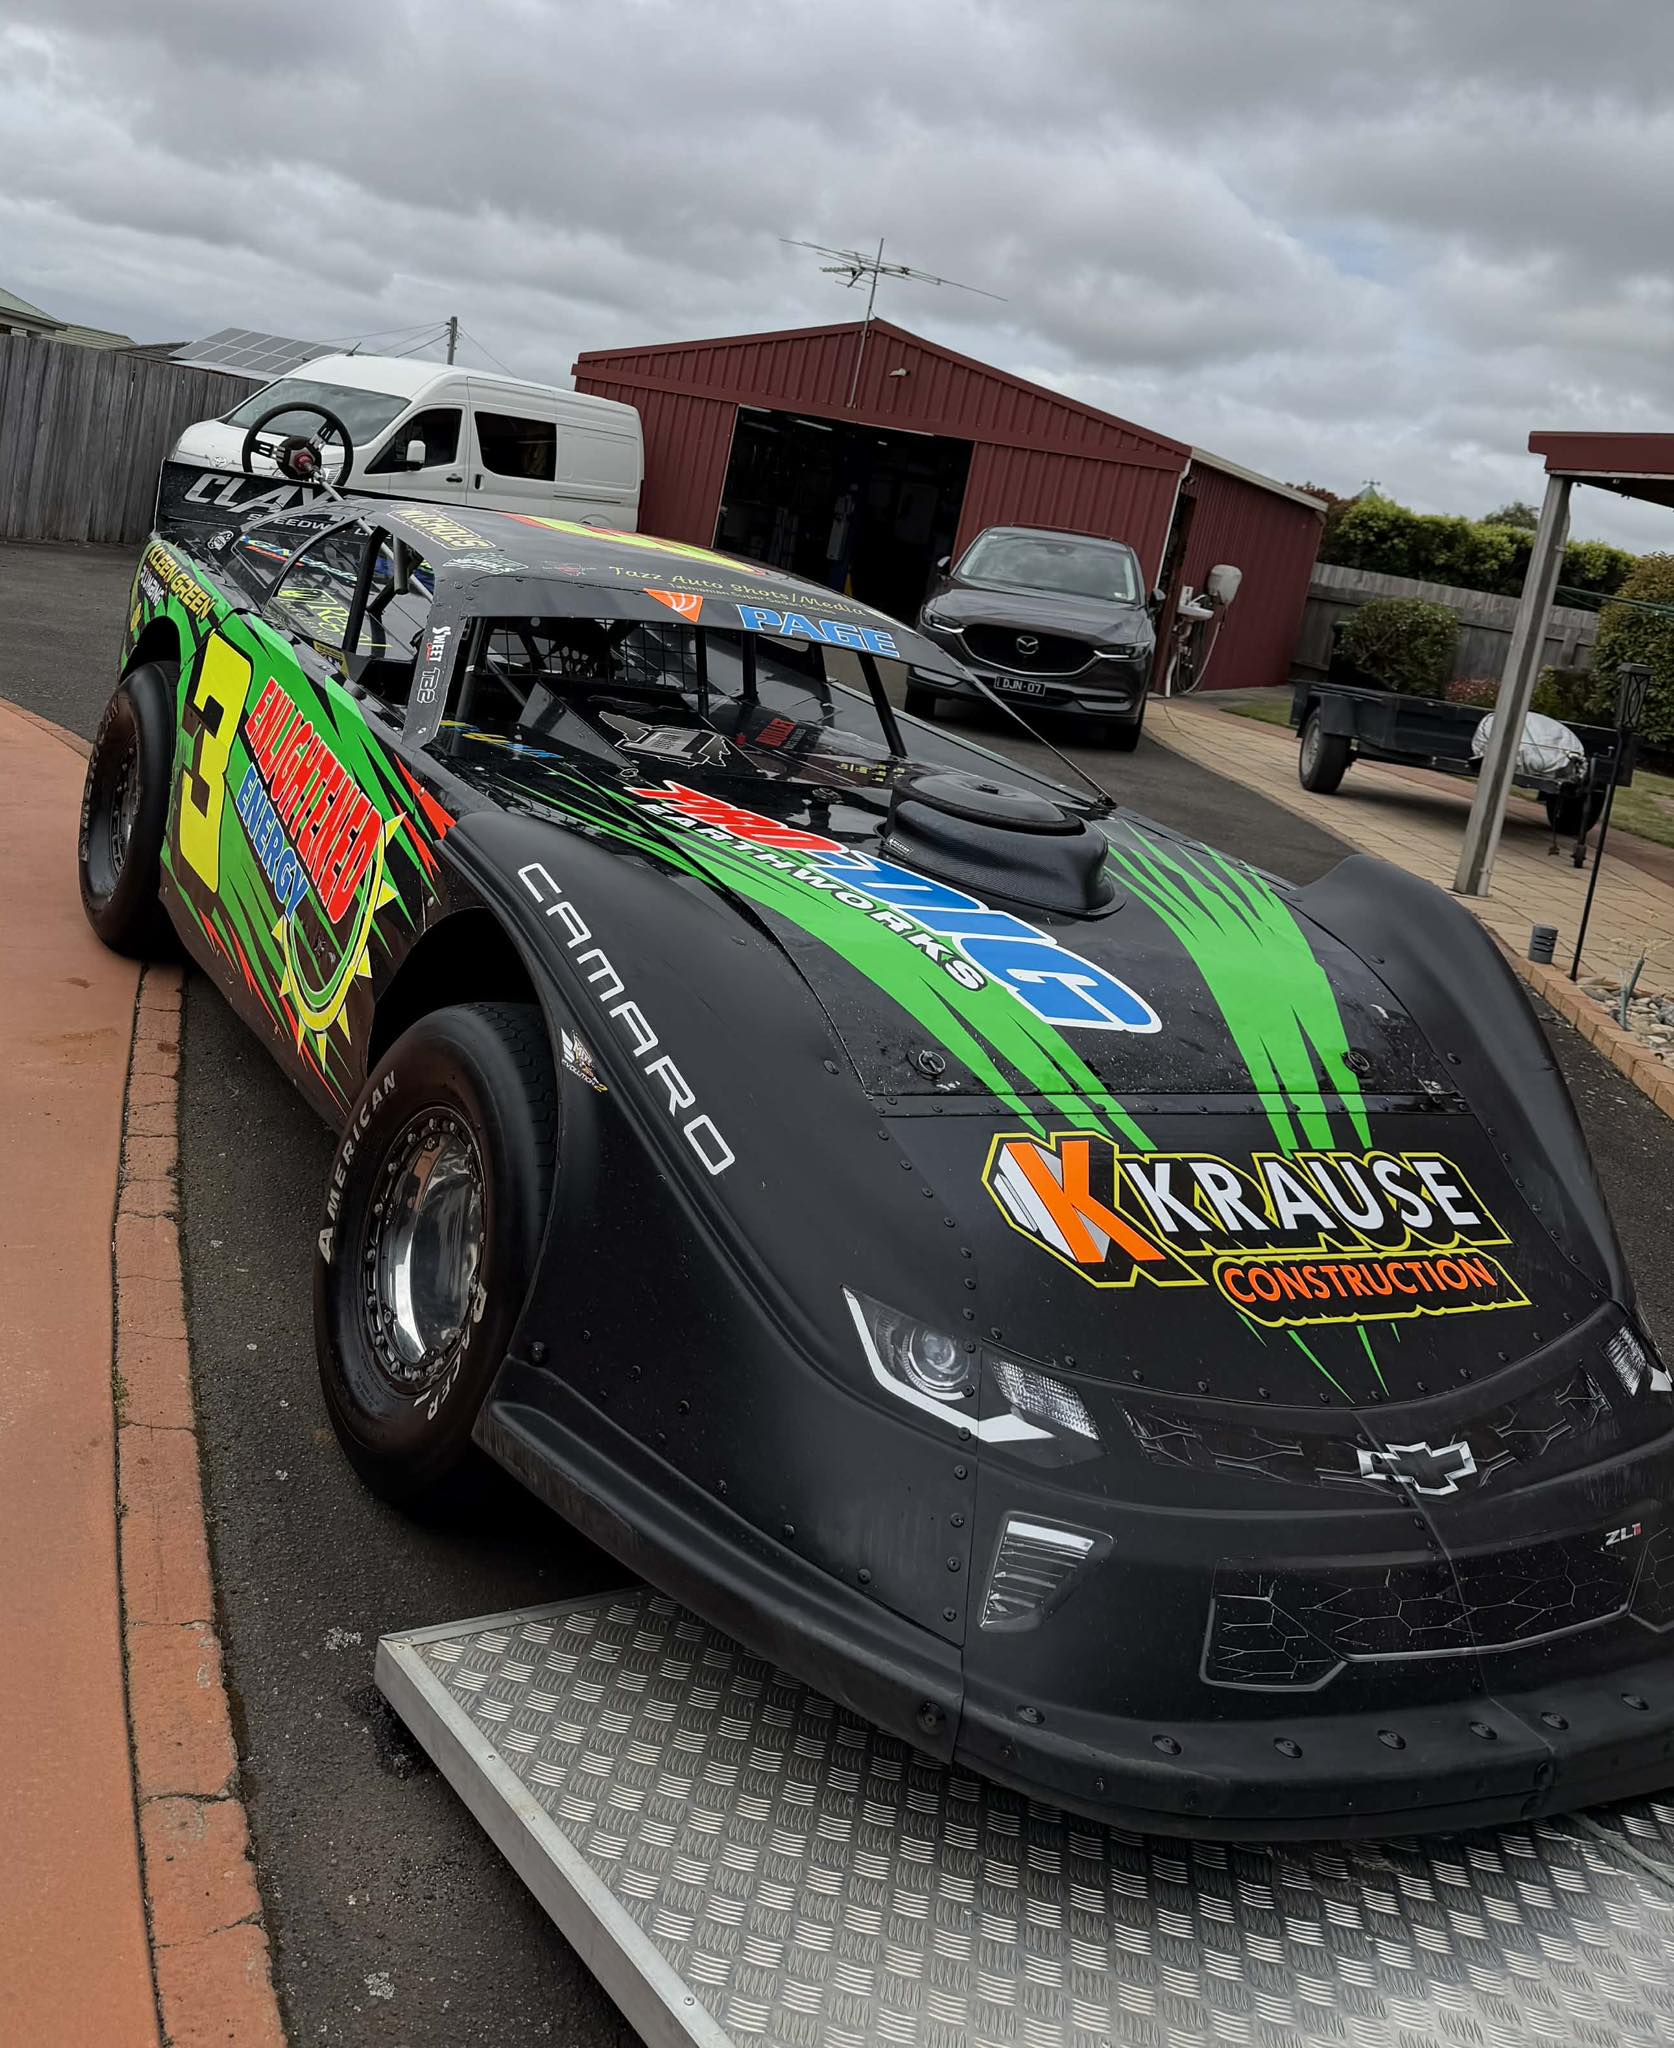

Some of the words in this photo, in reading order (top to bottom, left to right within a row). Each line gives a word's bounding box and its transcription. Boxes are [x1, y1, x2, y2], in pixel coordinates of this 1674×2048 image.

[147, 544, 181, 583] KLEEN
[170, 573, 216, 620] GREEN
[609, 566, 663, 581] Tazz
[672, 576, 723, 589] Auto
[736, 603, 901, 658] PAGE
[429, 625, 452, 662] SWEET
[179, 628, 253, 893] 3
[244, 675, 383, 925] ENLIGHTENED
[235, 762, 311, 922] ENERGY
[636, 803, 988, 990] EARTHWORKS
[517, 862, 736, 1176] CAMARO
[318, 1070, 396, 1265] AMERICAN
[1125, 1161, 1482, 1233] KRAUSE
[1223, 1257, 1498, 1303] CONSTRUCTION
